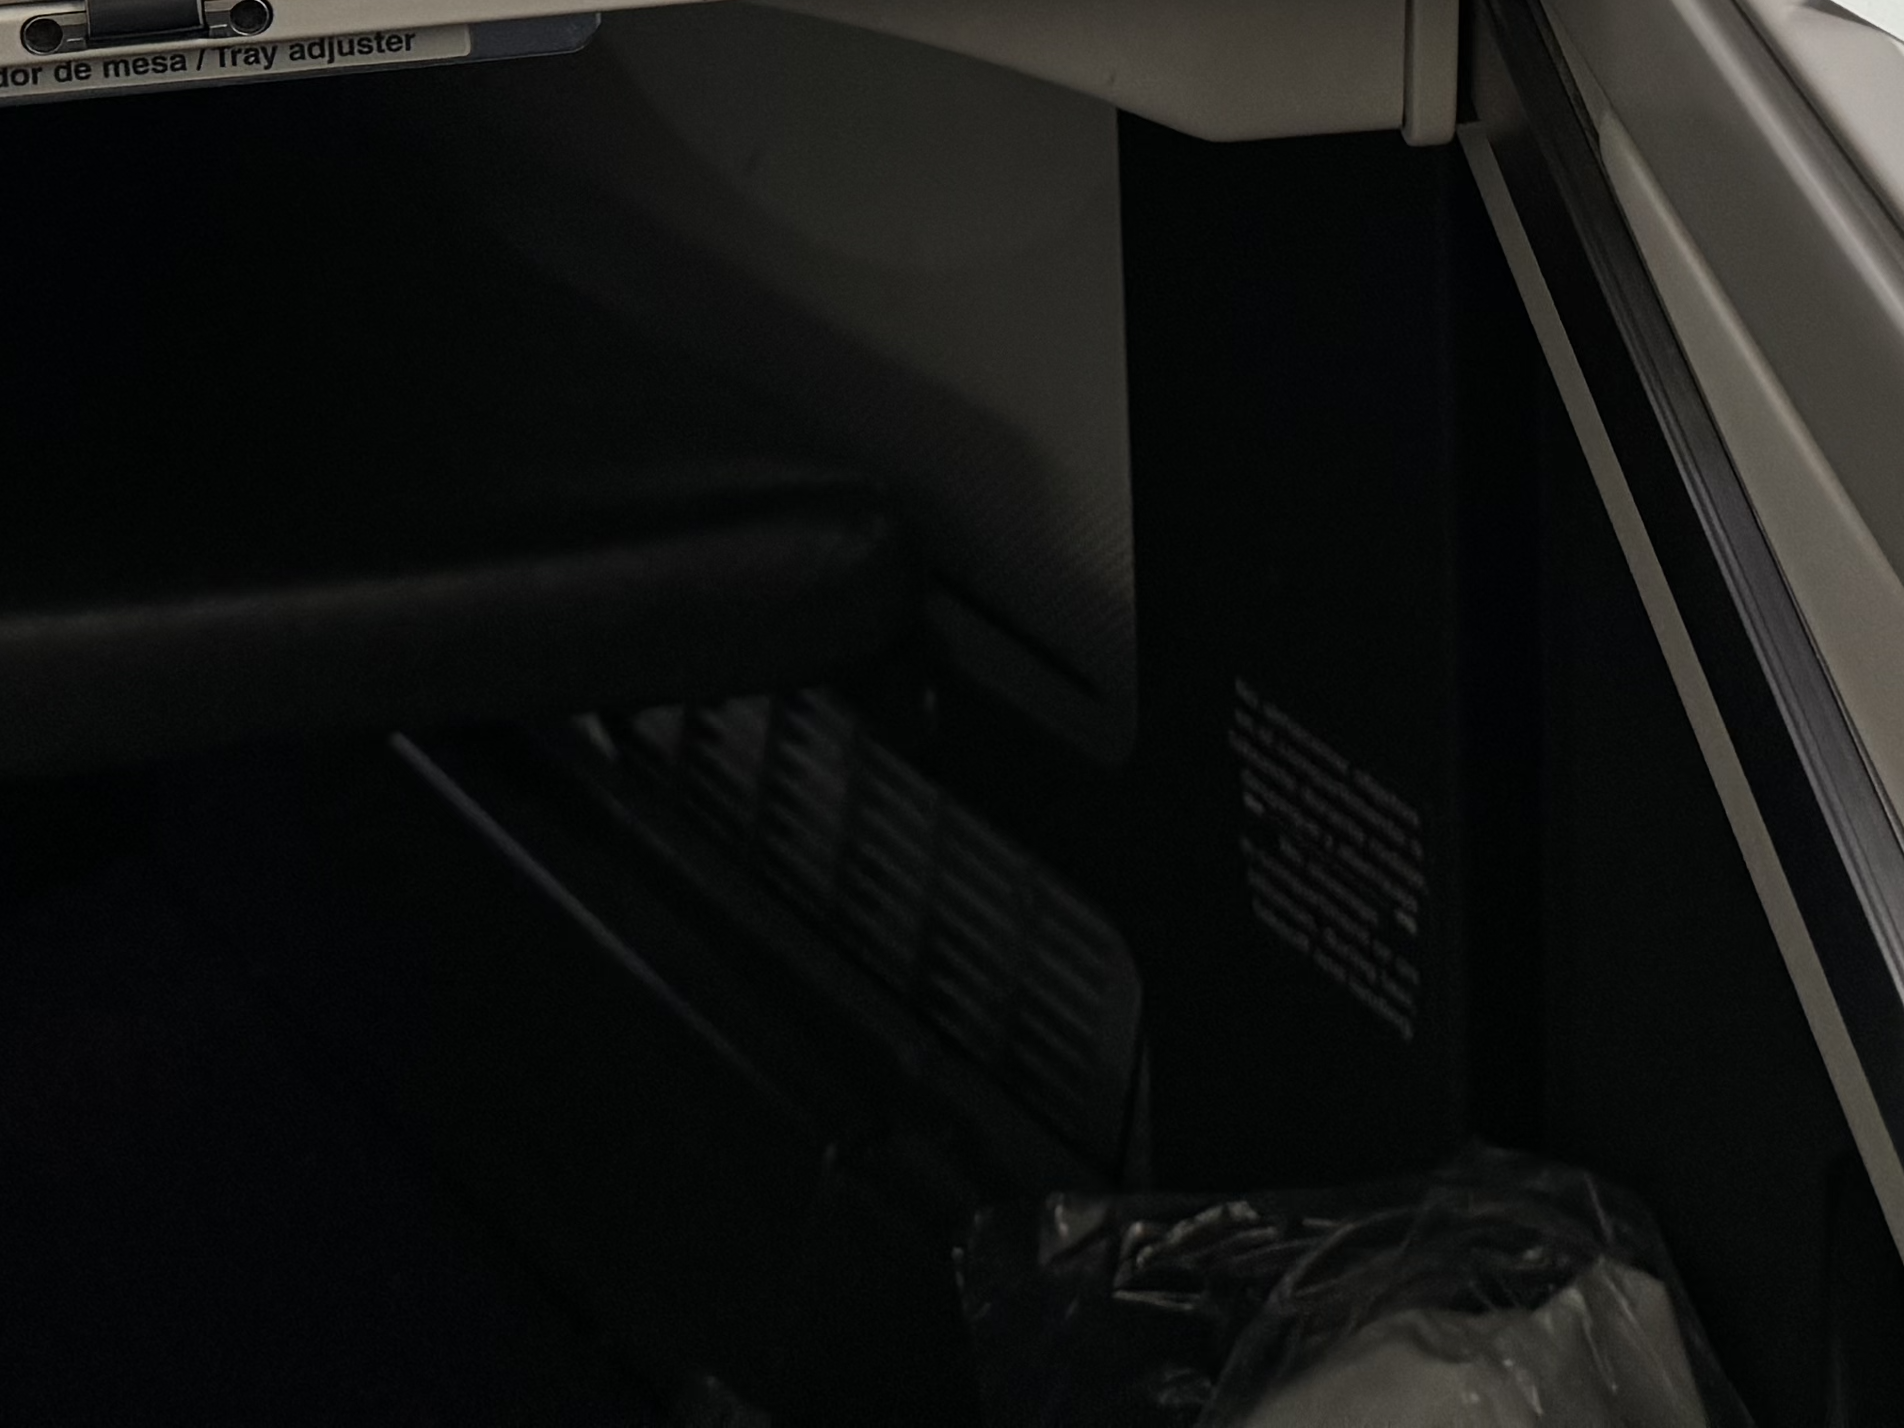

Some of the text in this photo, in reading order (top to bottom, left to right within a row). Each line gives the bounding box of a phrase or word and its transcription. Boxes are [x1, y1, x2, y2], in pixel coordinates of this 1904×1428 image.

[53, 56, 92, 83] de
[103, 51, 188, 79] mesa
[196, 48, 207, 72] /
[210, 43, 278, 70] Tray
[289, 32, 416, 64] adjuster
